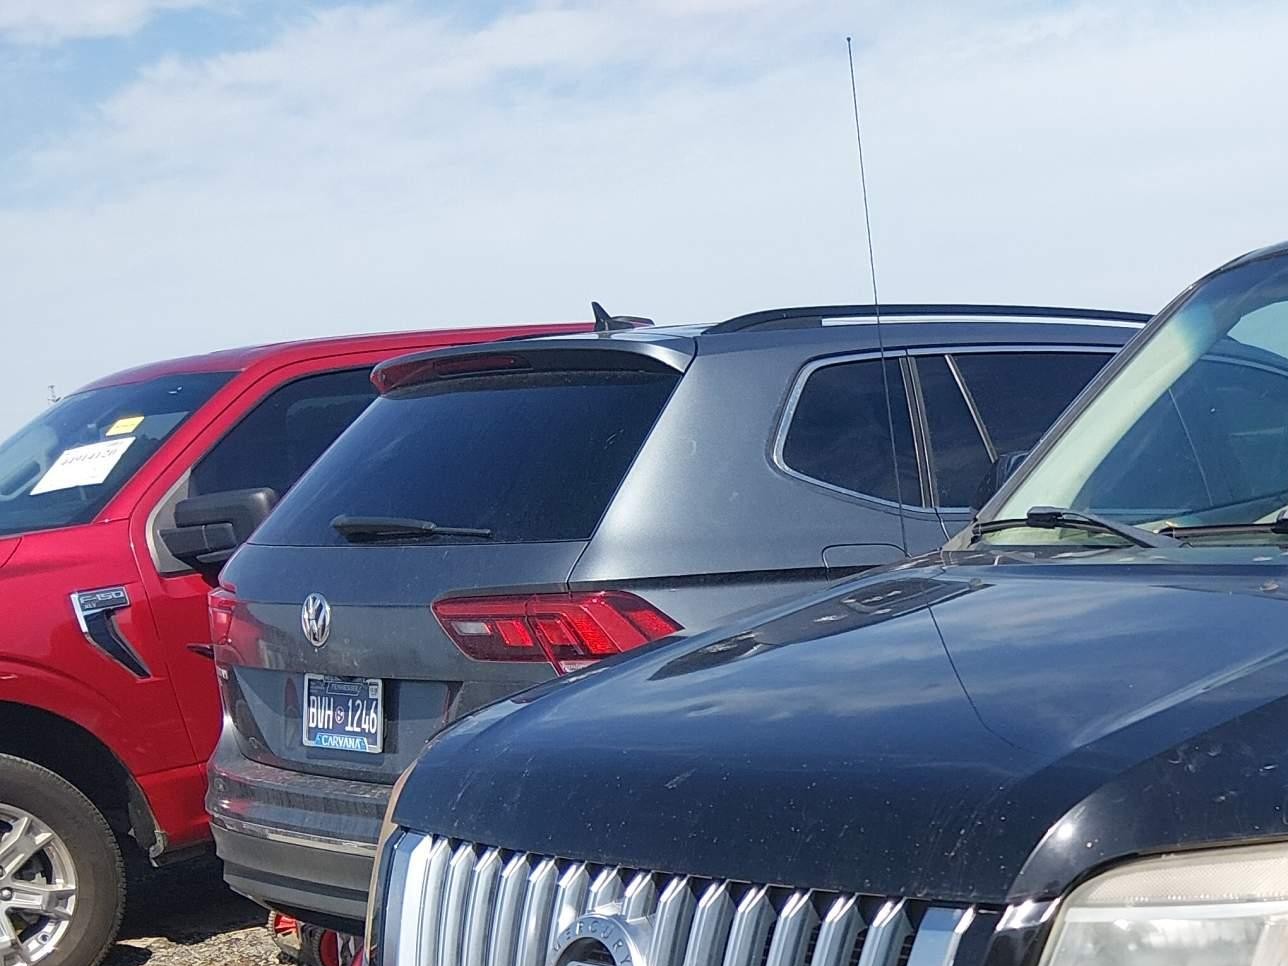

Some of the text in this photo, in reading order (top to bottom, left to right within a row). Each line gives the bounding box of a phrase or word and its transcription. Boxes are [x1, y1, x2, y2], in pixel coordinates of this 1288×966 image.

[79, 591, 125, 604] F-150
[308, 695, 378, 734] BVH 1246
[321, 735, 361, 750] CARVANA
